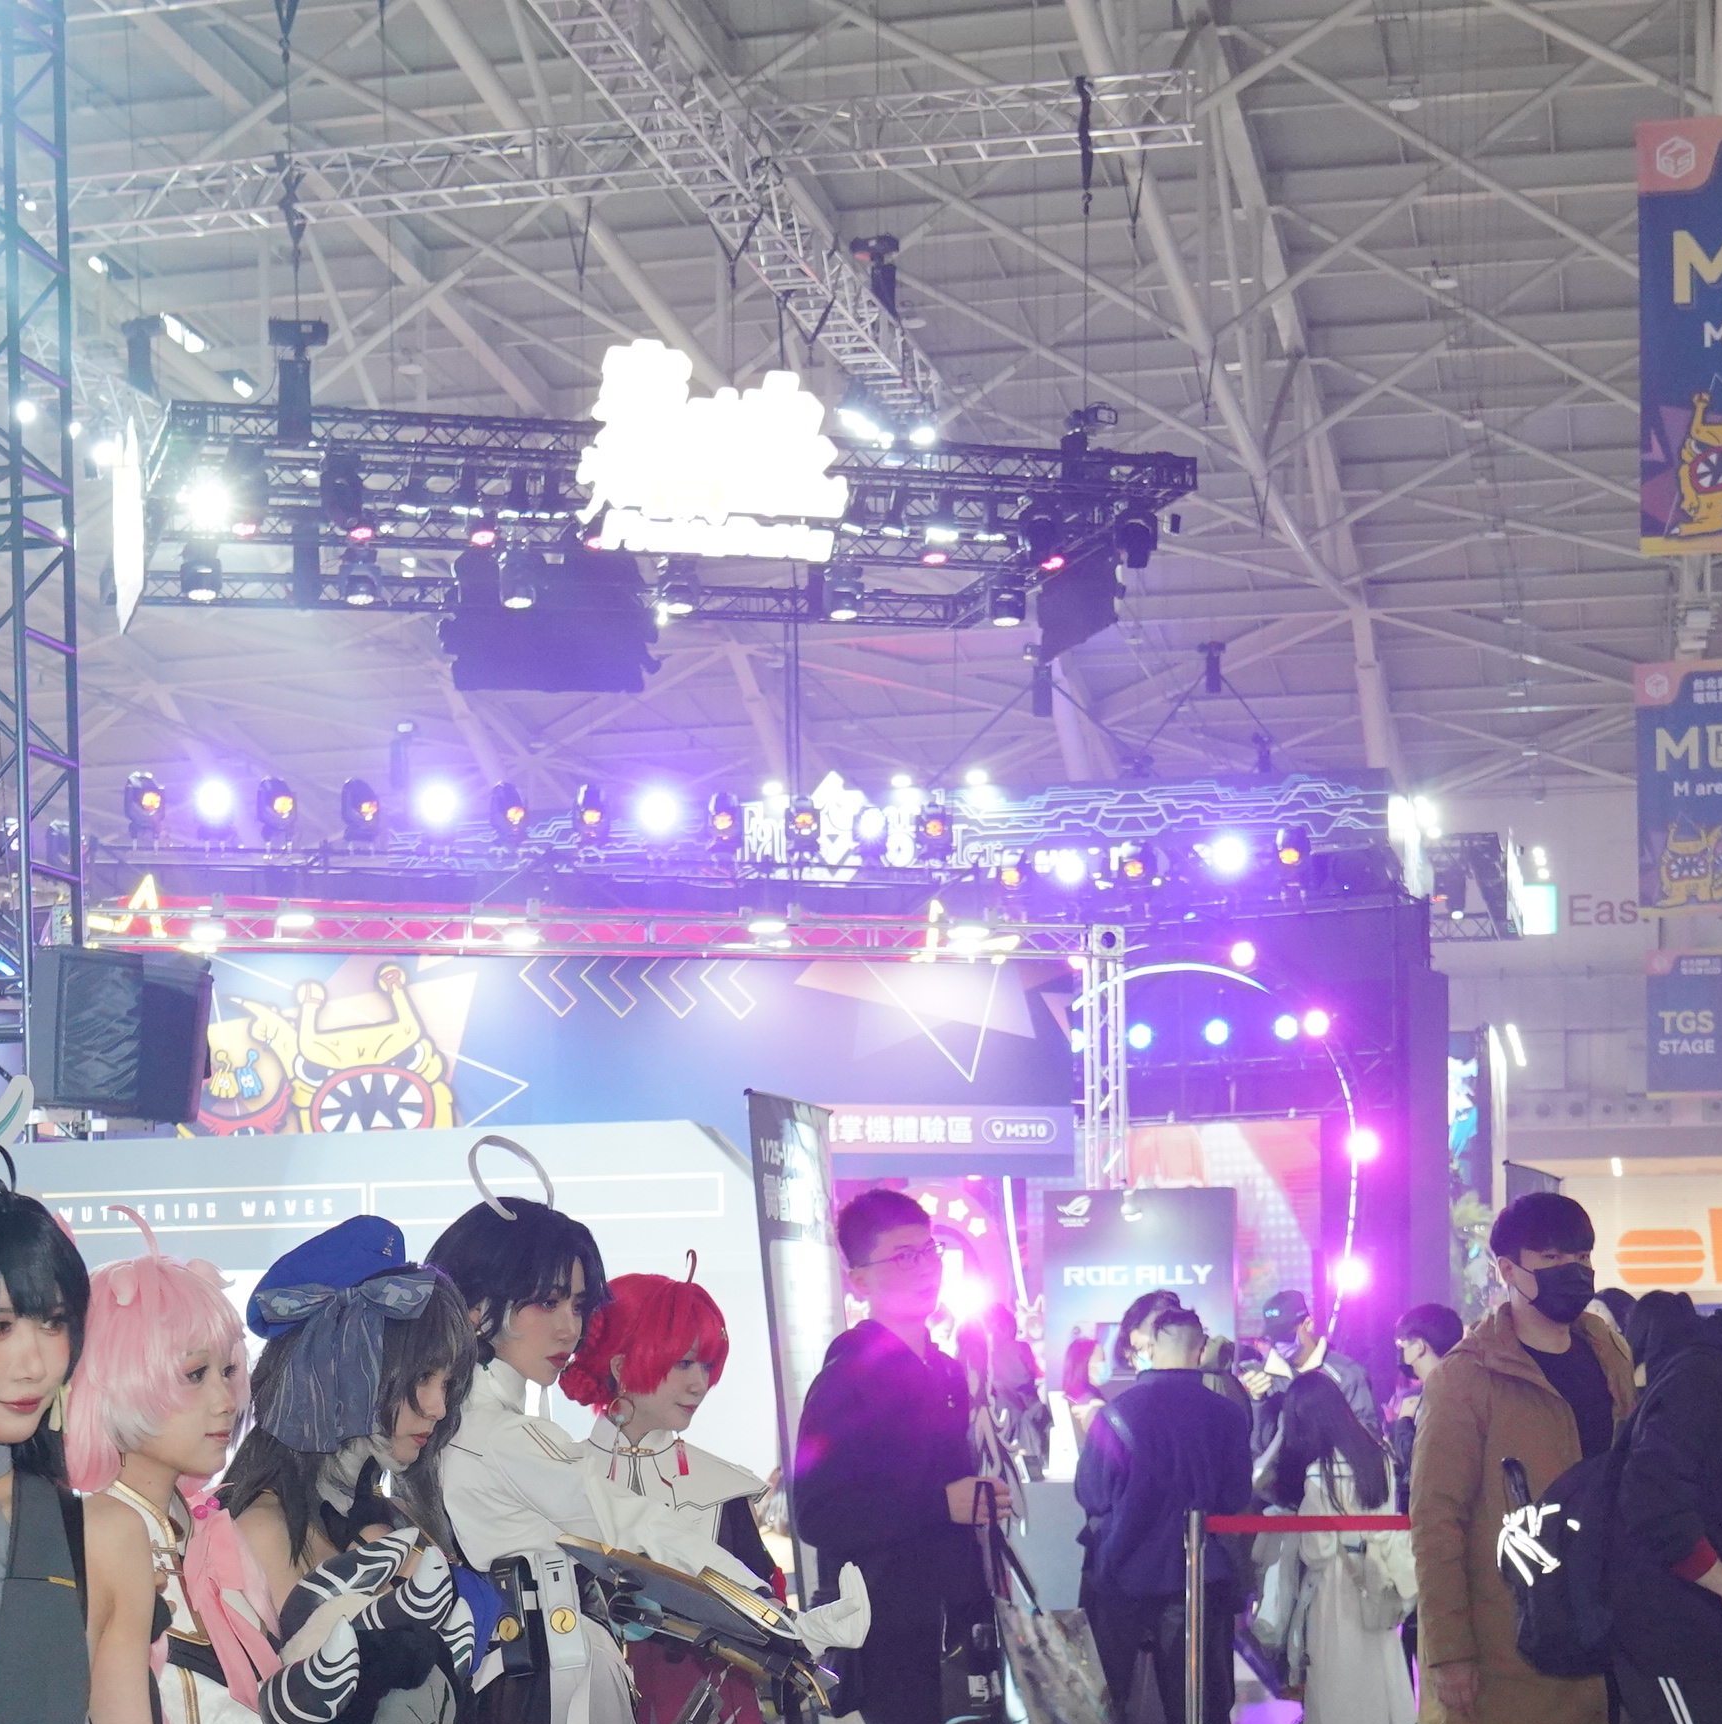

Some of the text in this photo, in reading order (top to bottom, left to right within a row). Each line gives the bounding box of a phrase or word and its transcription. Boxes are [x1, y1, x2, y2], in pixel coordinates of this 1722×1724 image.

[1673, 781, 1689, 796] M
[1569, 894, 1650, 926] Eas
[1658, 1010, 1715, 1034] TGS
[1658, 1039, 1715, 1054] STAGE
[1006, 1123, 1047, 1138] M310
[241, 1198, 334, 1218] WAVES
[1064, 1264, 1214, 1286] ROG ALLY
